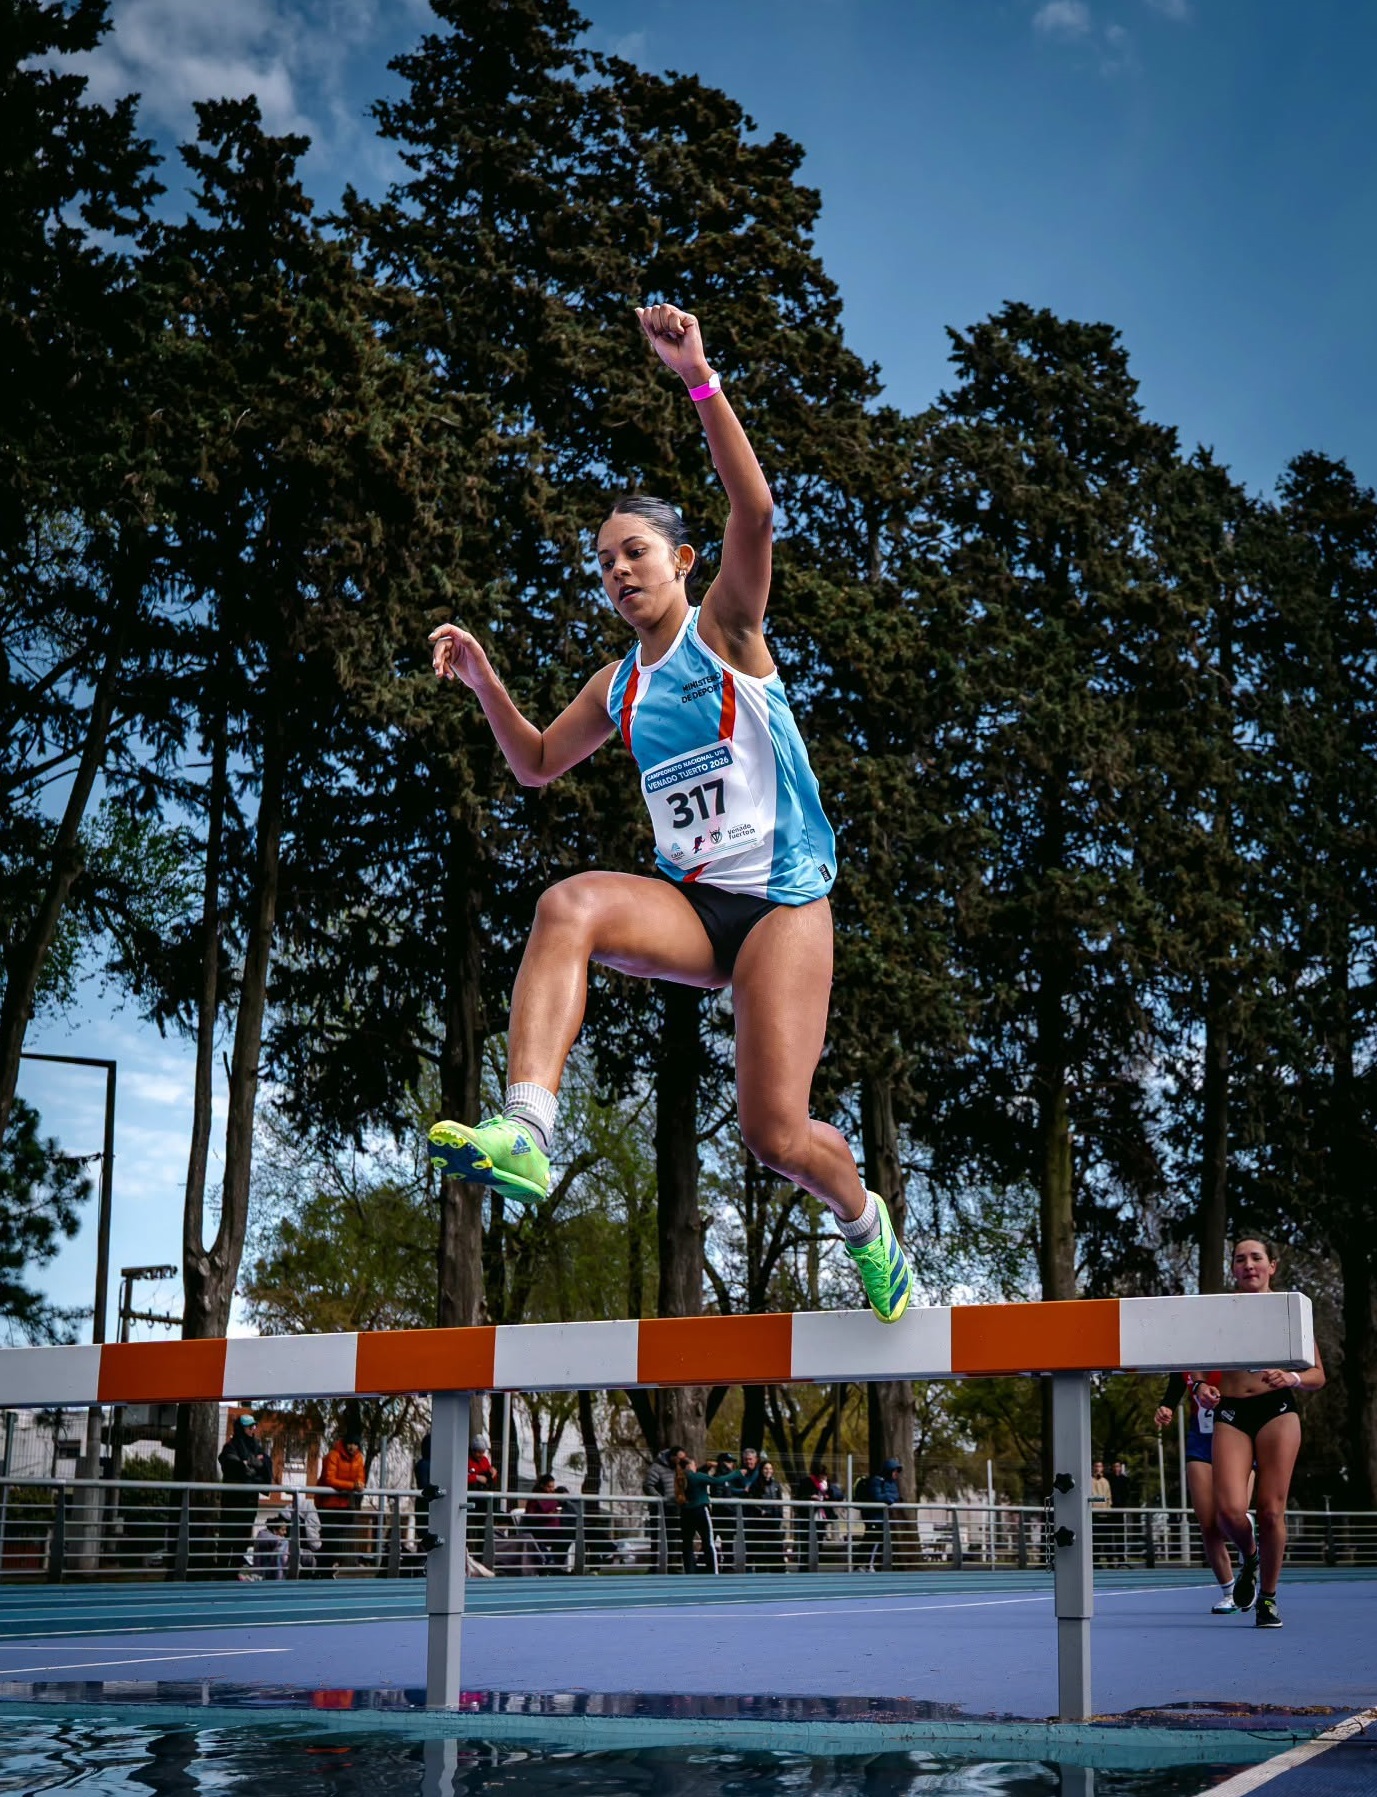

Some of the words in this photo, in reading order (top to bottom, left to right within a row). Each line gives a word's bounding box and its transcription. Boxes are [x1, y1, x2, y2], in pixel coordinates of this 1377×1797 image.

[682, 694, 692, 703] DE
[647, 765, 682, 781] CAMPEONATO
[683, 755, 714, 767] NACIONAL
[647, 774, 678, 791] VENADO
[678, 764, 708, 779] TUERTO
[709, 757, 729, 768] 2026
[666, 778, 726, 829] 317
